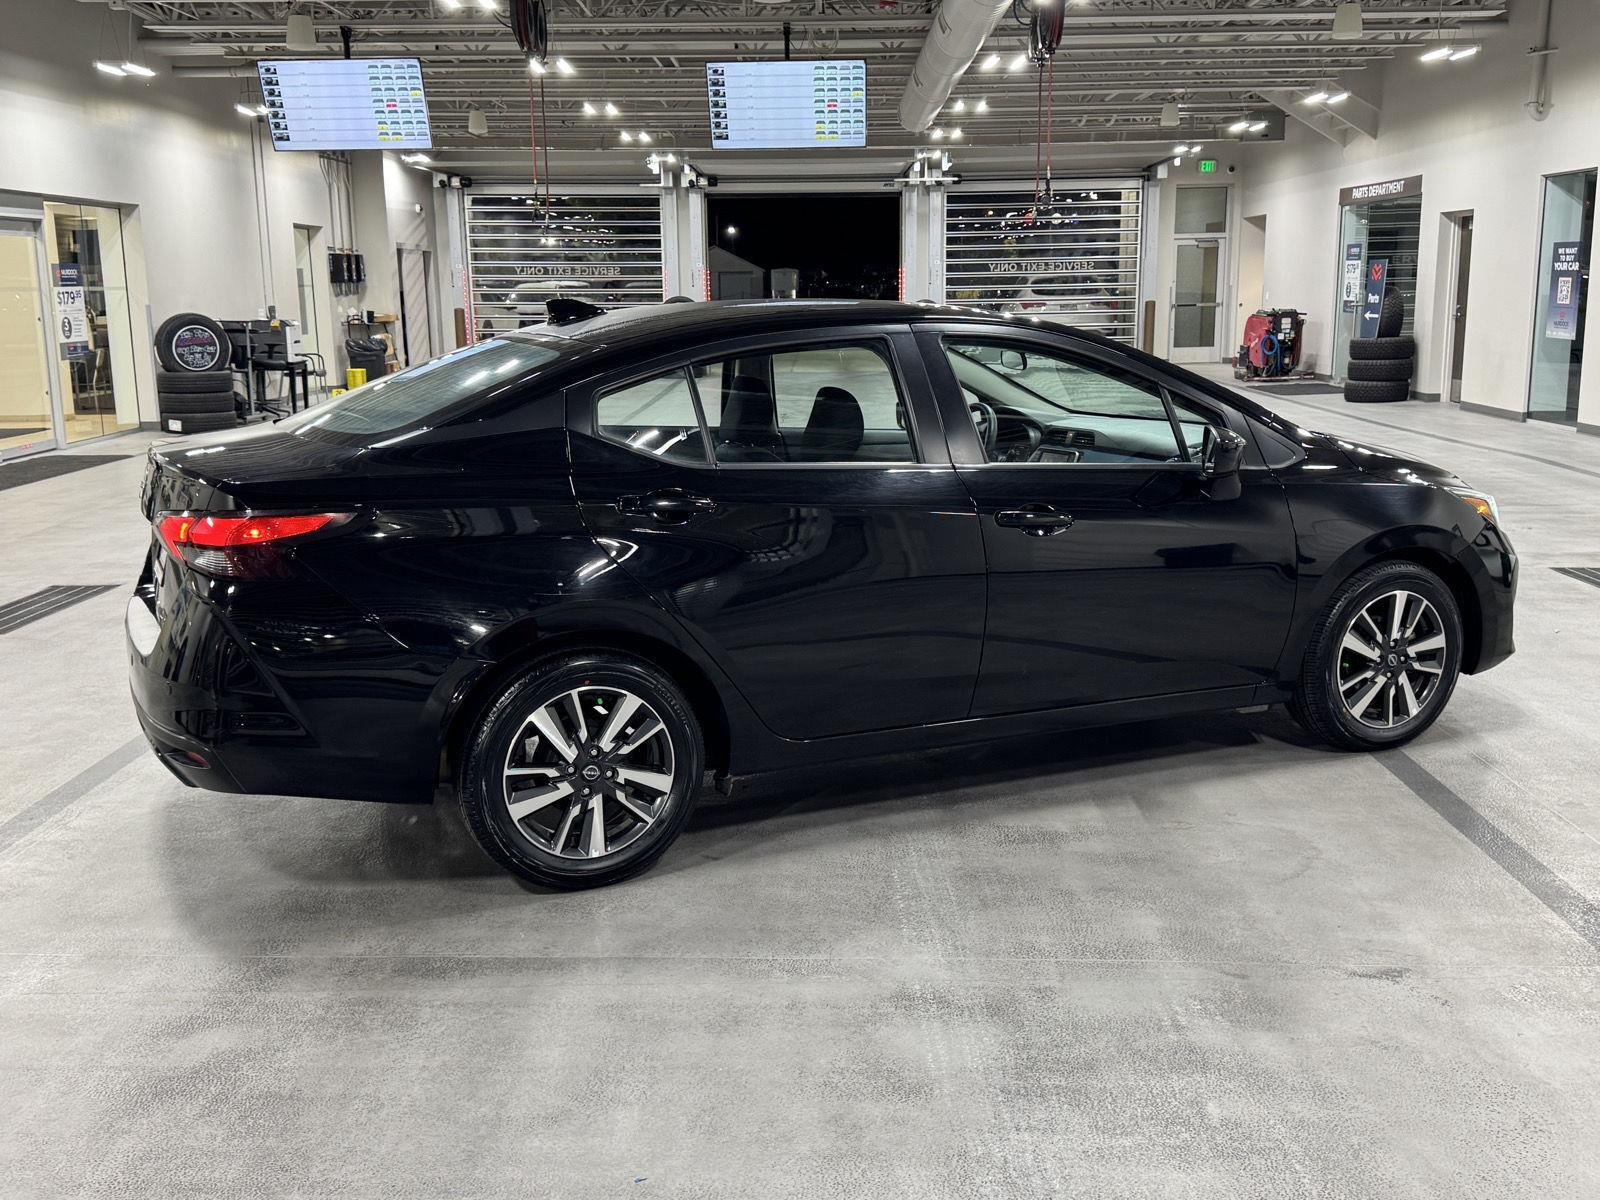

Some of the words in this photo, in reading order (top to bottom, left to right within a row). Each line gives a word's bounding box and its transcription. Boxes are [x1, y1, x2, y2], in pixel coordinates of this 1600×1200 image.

[1201, 160, 1216, 172] EXIT
[1352, 186, 1368, 199] PARTS
[1368, 180, 1405, 197] DEPARTMENT
[1554, 262, 1567, 271] YOUR
[1568, 262, 1579, 271] CAR
